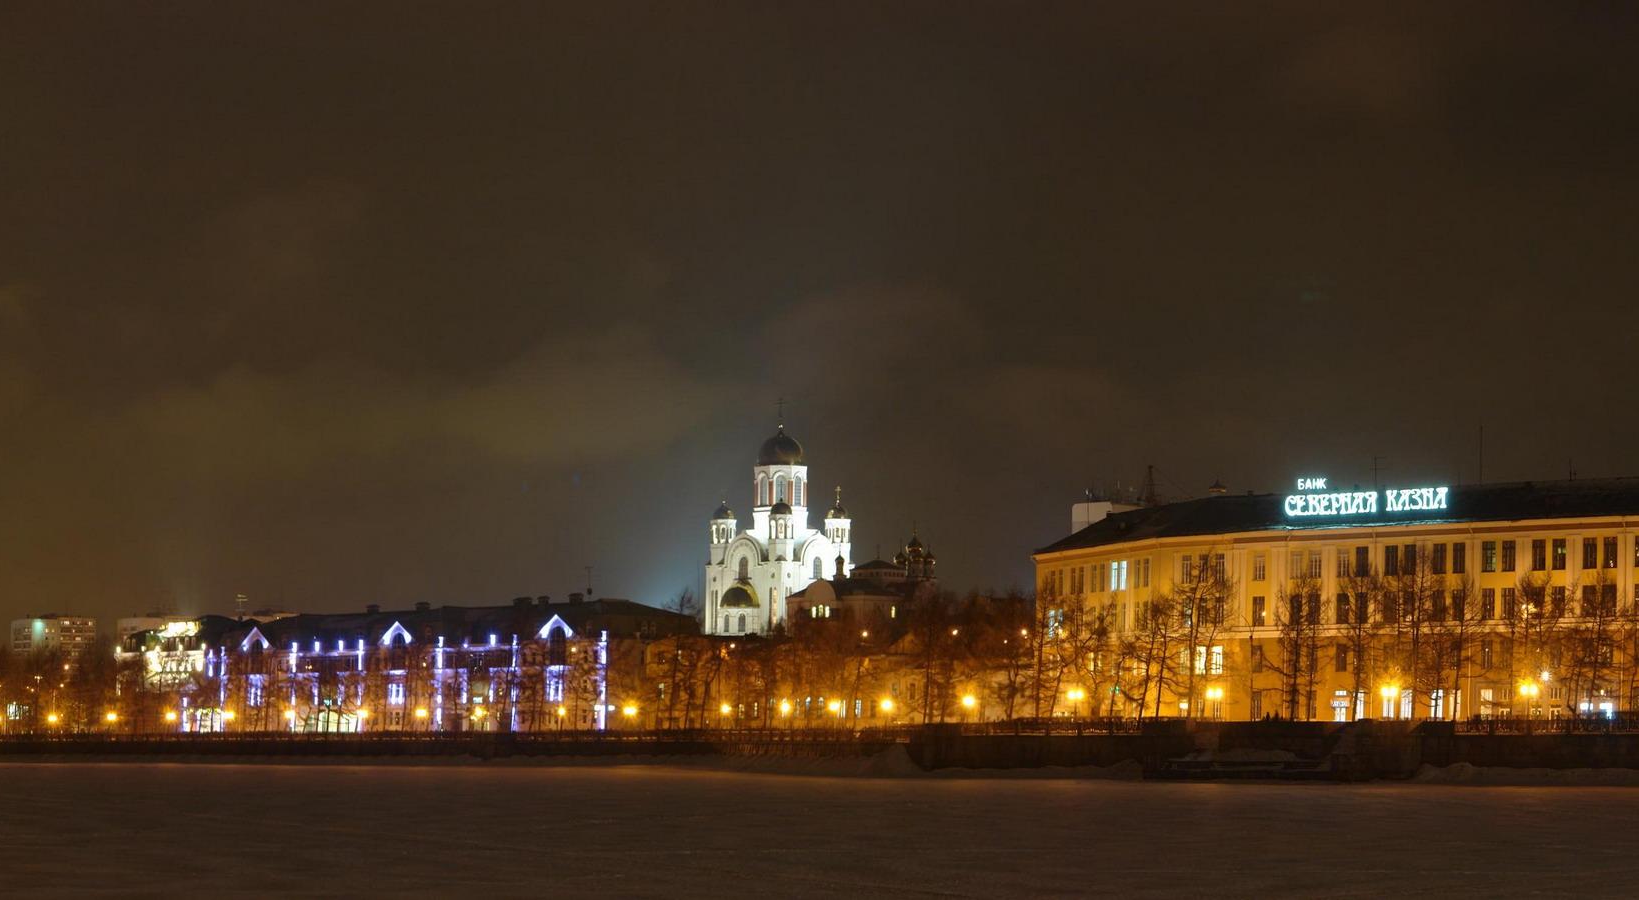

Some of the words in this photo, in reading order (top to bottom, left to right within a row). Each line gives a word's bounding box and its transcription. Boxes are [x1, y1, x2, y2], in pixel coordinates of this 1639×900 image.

[1297, 478, 1327, 490] БАНК
[1284, 491, 1378, 516] СЕВЕРНАЯ
[1385, 487, 1448, 511] КАЗНА
